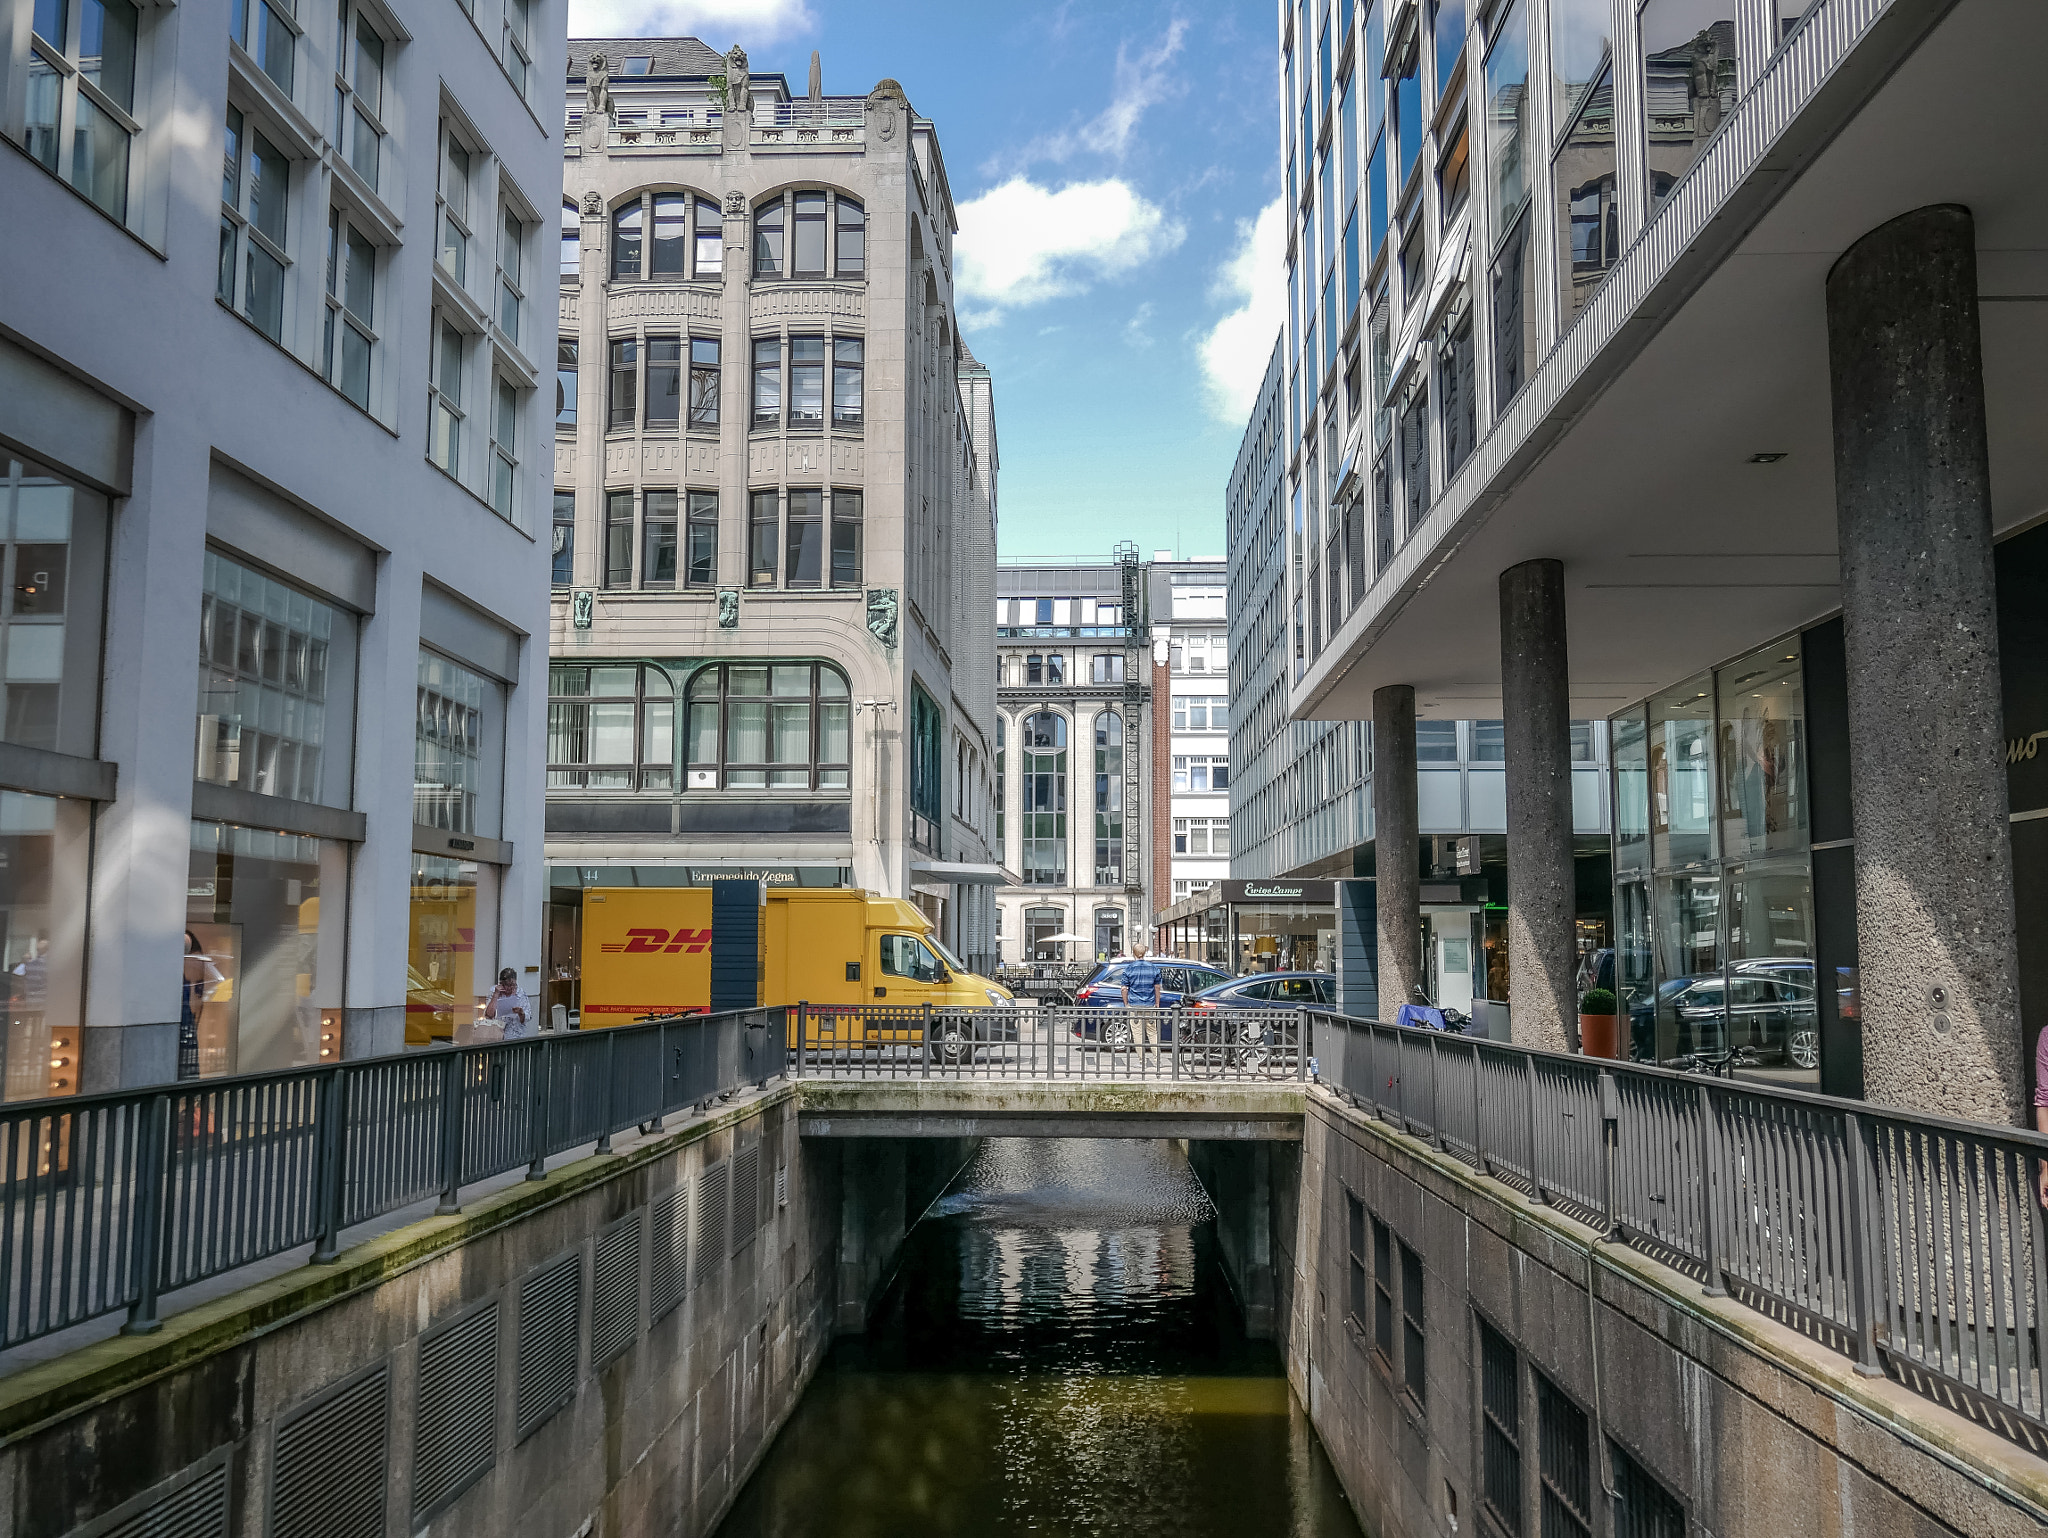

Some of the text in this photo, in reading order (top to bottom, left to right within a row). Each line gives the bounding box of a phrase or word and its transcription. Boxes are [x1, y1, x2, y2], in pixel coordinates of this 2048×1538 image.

[584, 870, 599, 880] 44
[761, 870, 795, 885] Zegna
[623, 928, 712, 953] DH
